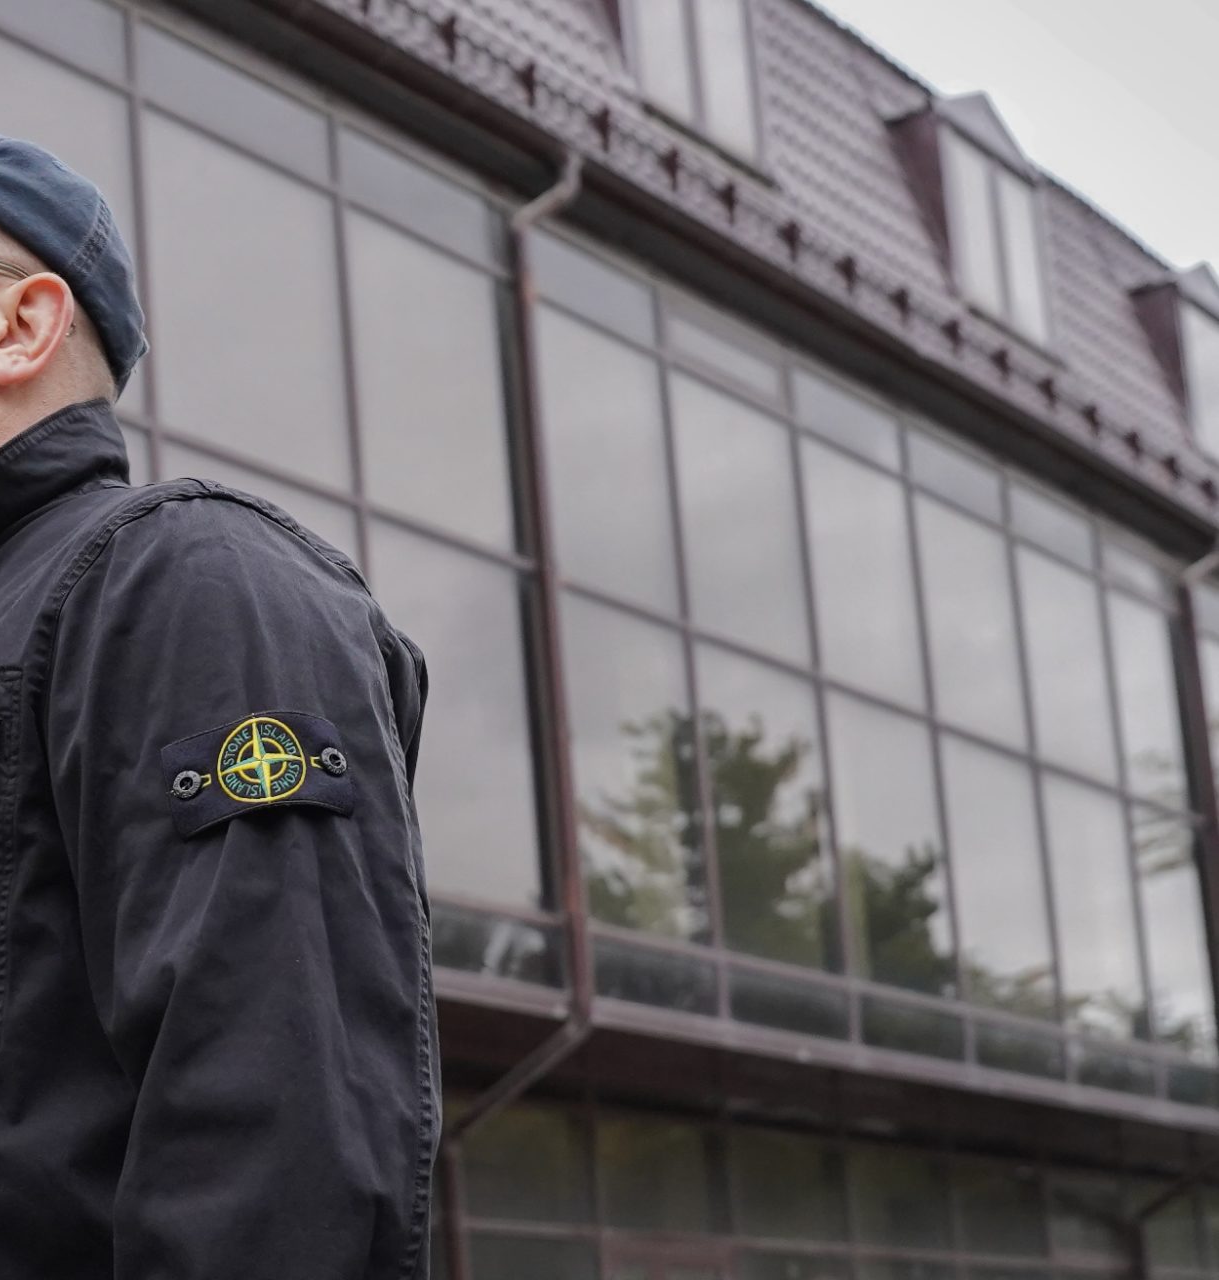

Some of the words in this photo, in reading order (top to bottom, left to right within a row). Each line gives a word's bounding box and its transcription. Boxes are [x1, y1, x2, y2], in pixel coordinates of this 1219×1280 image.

[223, 728, 251, 766] STONE
[260, 724, 297, 755] ISLAND
[225, 772, 262, 796] ISLAND
[273, 761, 300, 793] STONE
